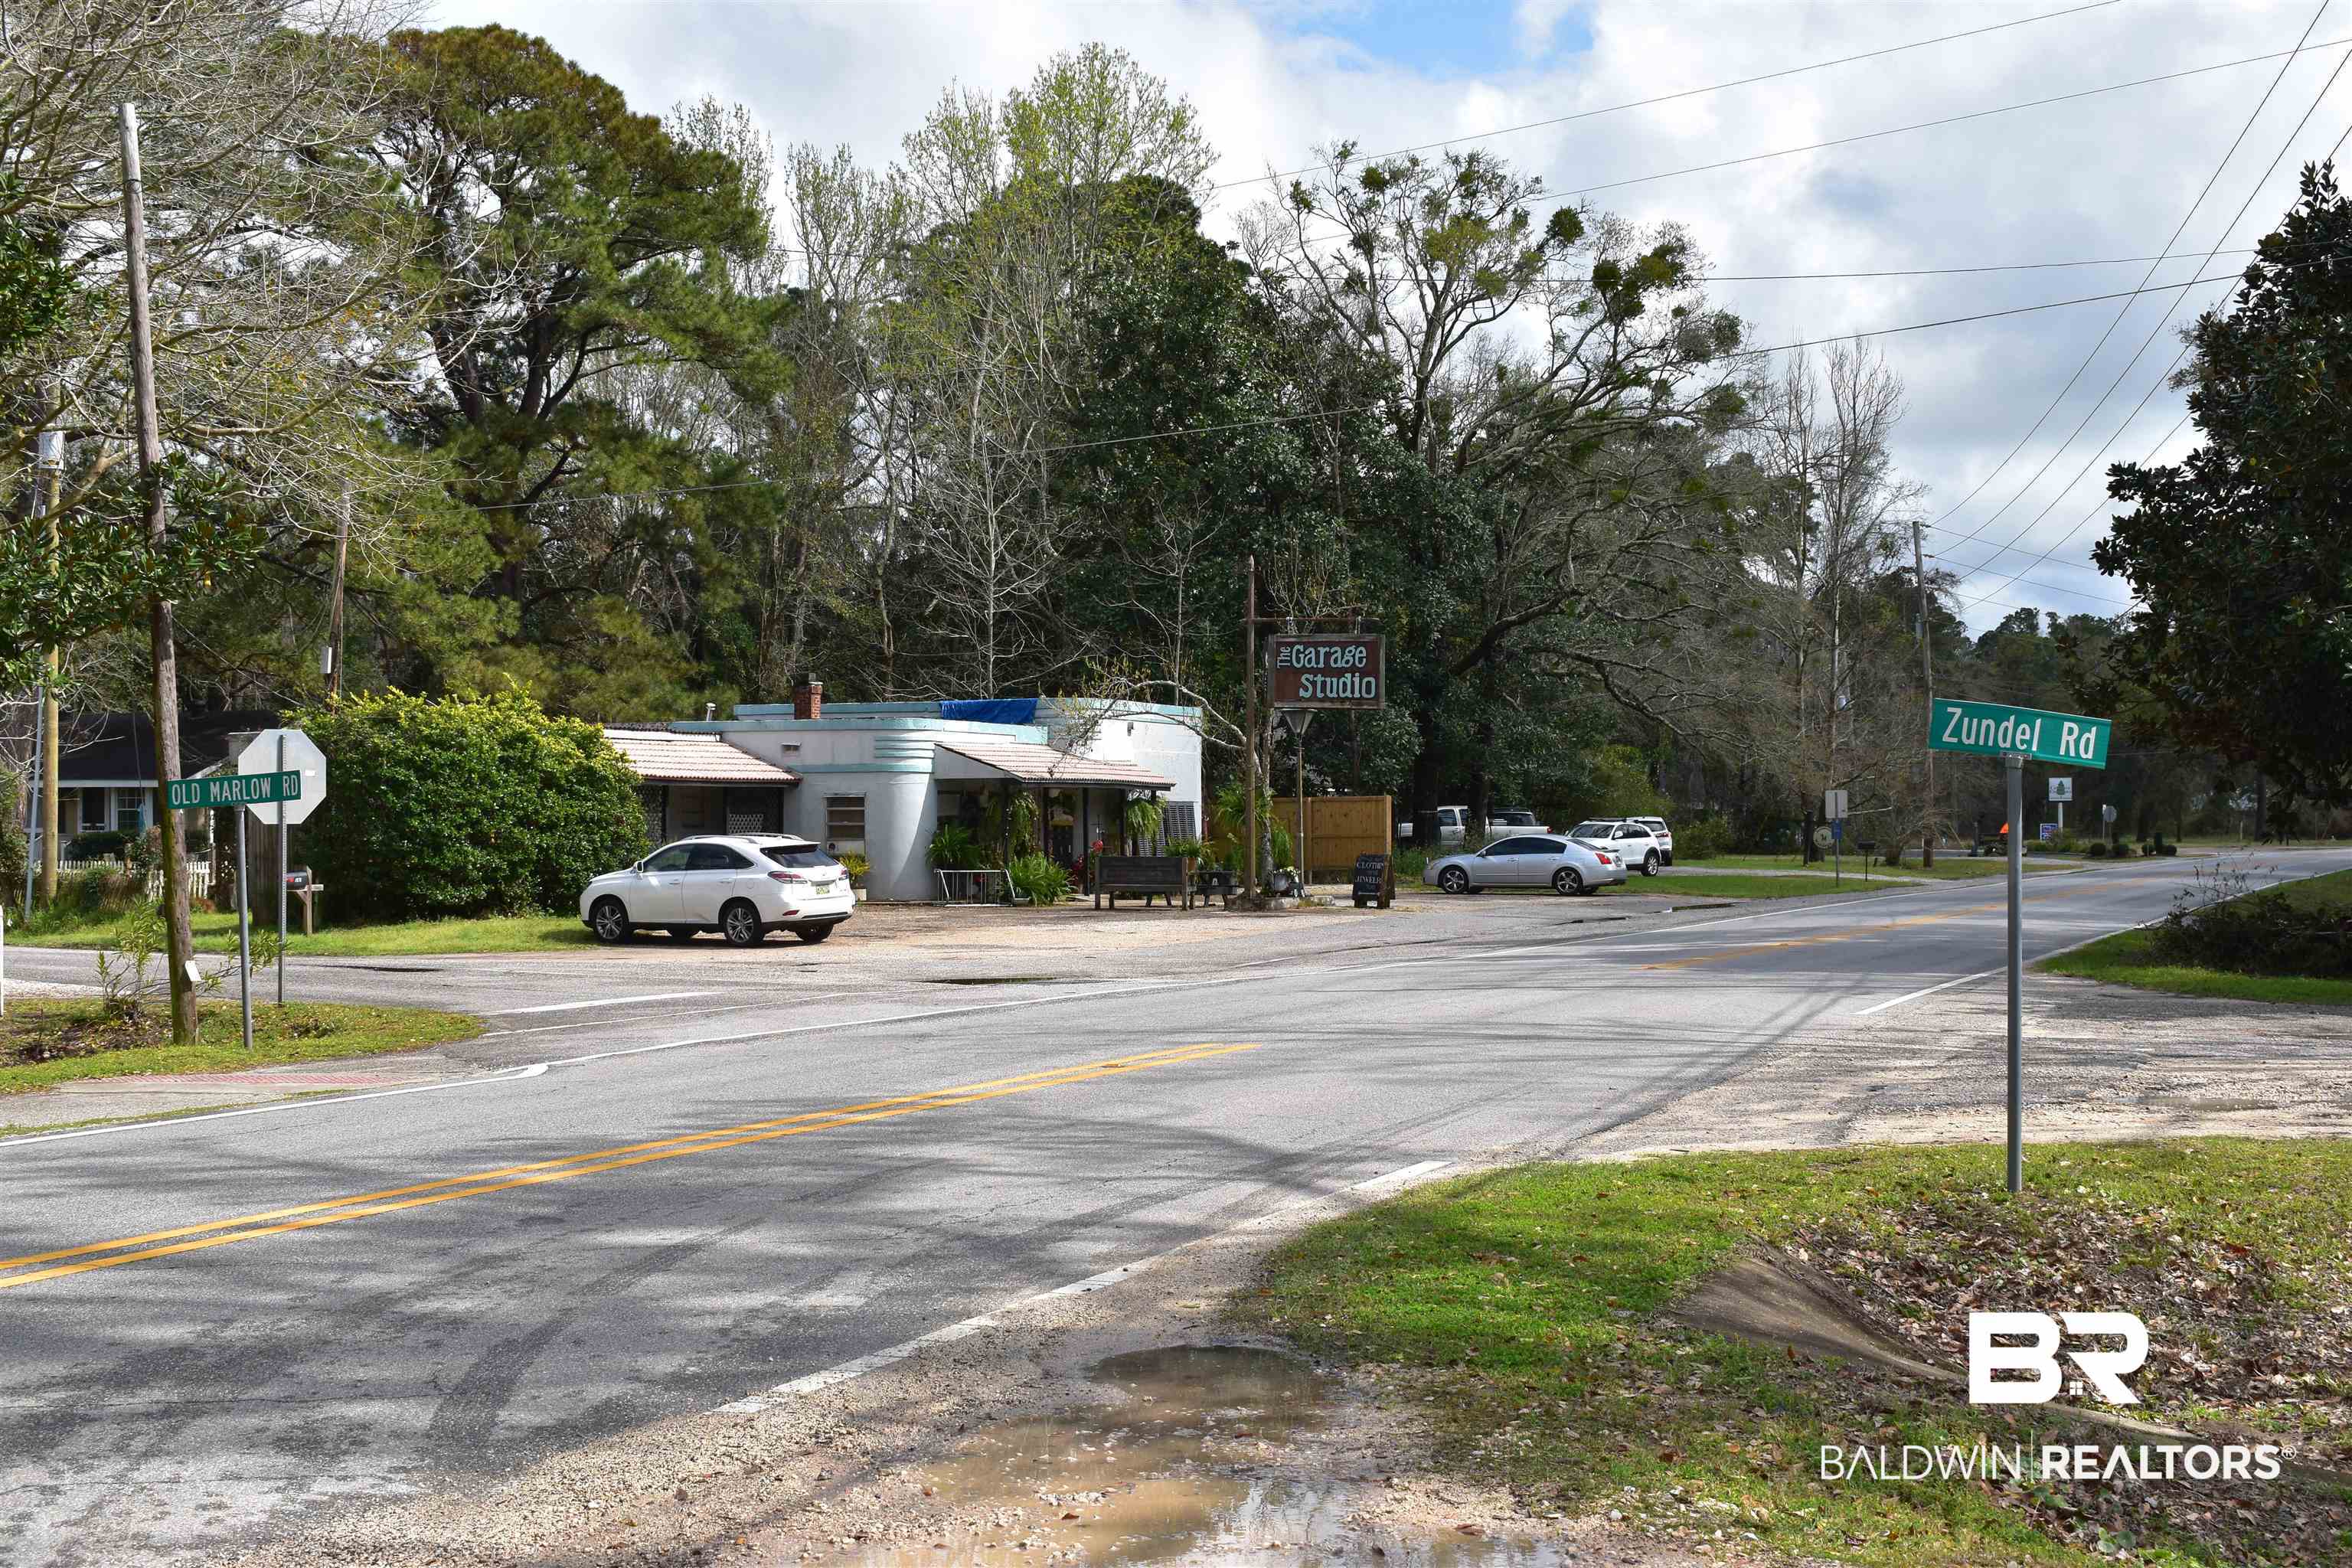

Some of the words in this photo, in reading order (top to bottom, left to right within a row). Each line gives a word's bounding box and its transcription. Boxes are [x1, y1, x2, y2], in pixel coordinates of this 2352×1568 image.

[1277, 646, 1291, 668] The
[1292, 644, 1367, 668] Garage
[1298, 672, 1376, 698] Studio
[1942, 707, 2042, 751] Zundel
[2059, 721, 2097, 760] Rd
[172, 782, 201, 805] OLD
[209, 777, 271, 802] MARLOW
[282, 775, 299, 797] RD
